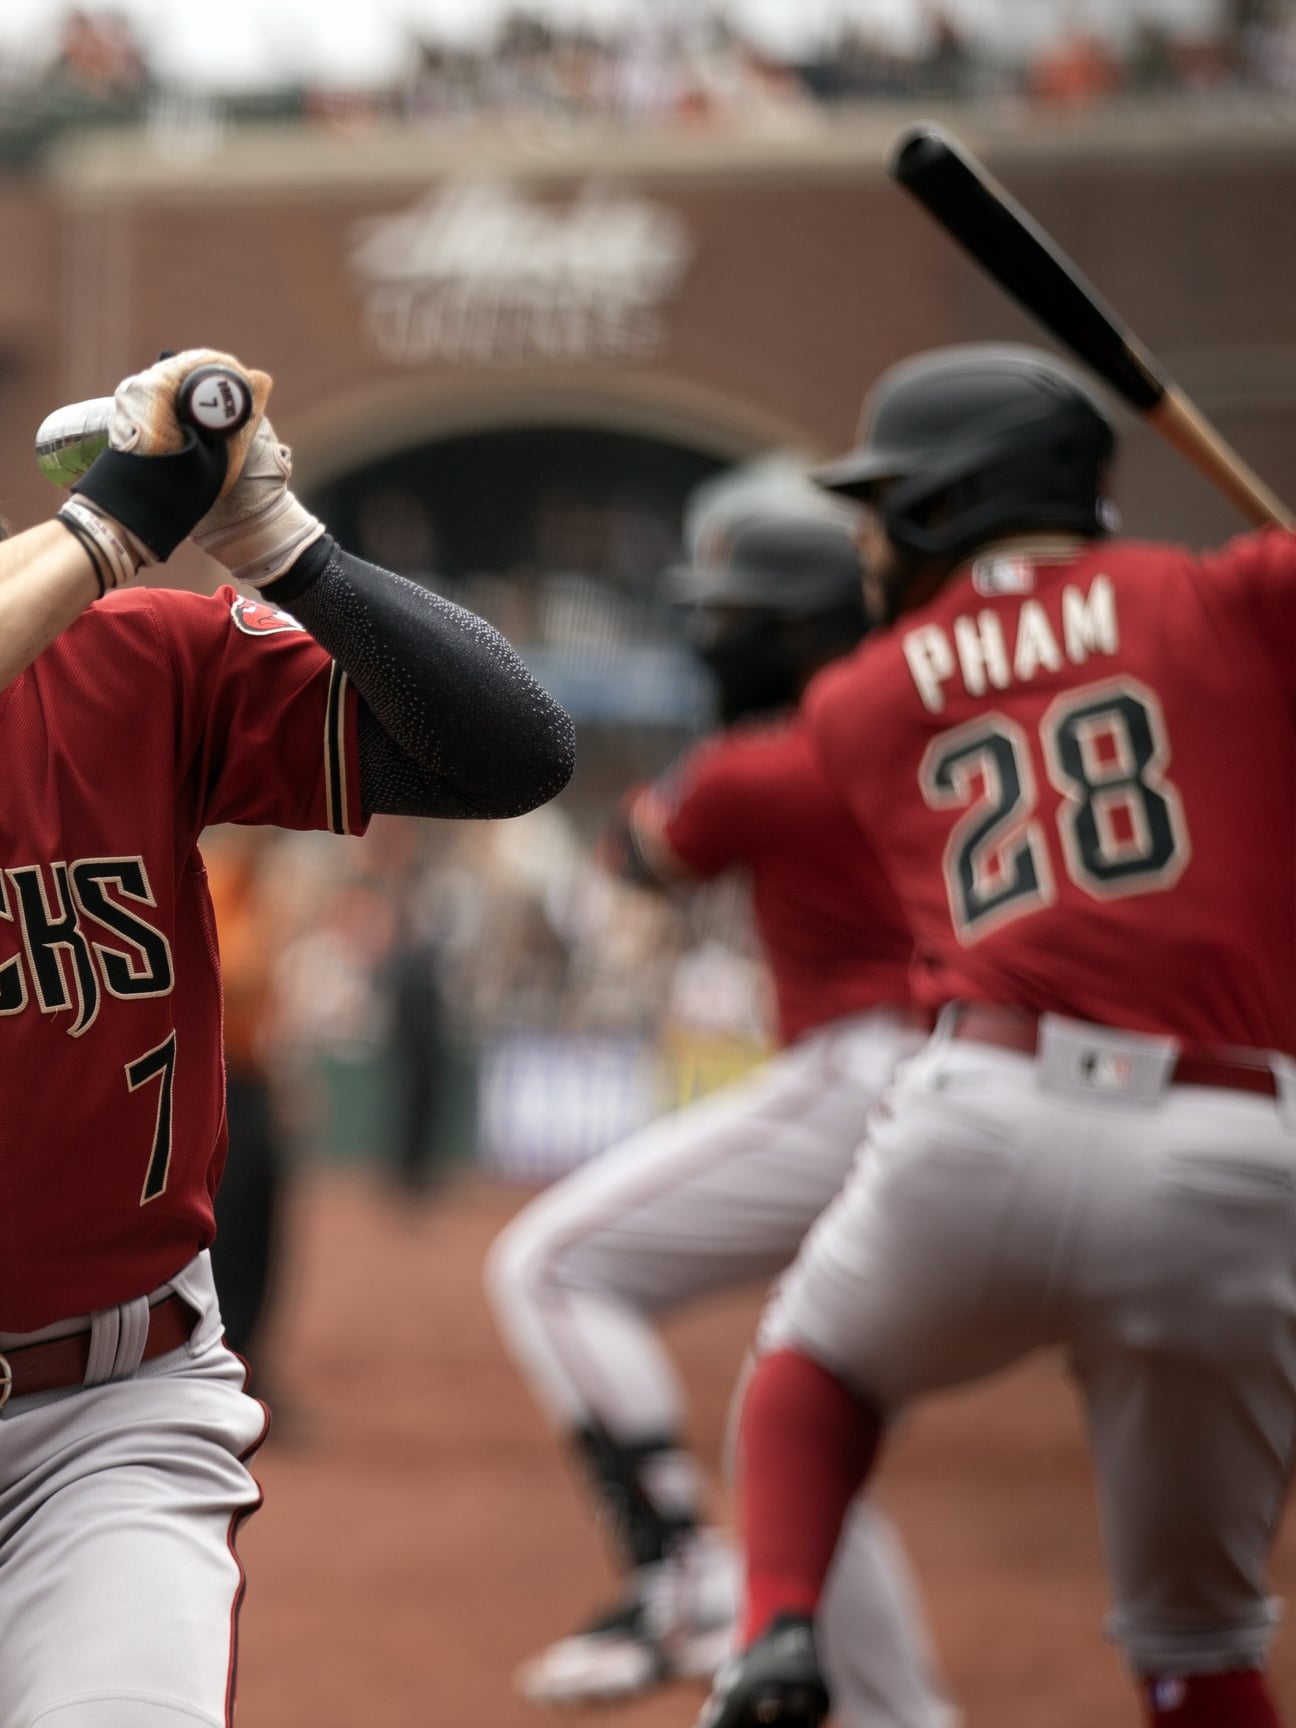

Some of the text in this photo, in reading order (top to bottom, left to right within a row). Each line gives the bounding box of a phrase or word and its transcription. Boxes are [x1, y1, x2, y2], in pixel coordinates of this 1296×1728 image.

[199, 397, 218, 408] 7
[903, 573, 1120, 714] PHAM
[917, 673, 1192, 948] 28
[124, 1028, 177, 1207] 7
